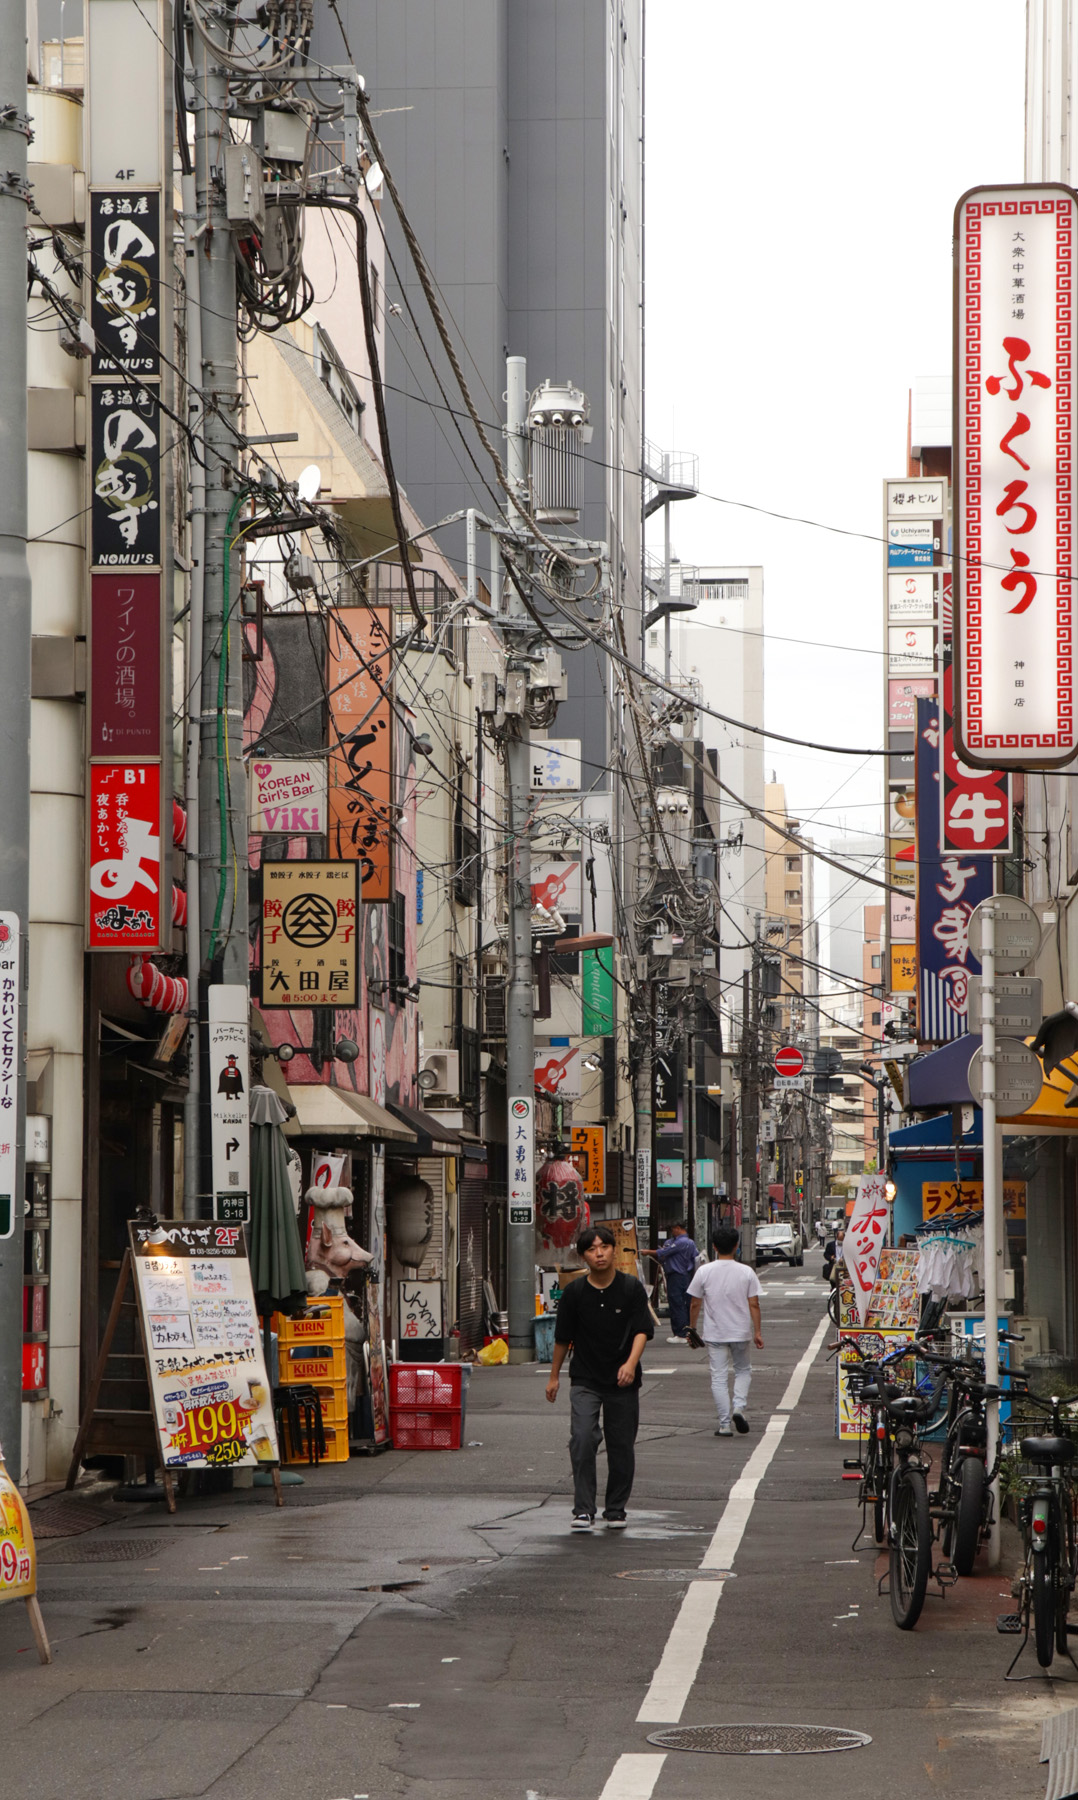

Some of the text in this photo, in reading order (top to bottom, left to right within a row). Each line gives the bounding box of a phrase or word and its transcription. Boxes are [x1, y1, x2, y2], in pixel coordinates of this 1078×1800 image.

[115, 169, 135, 180] 4F
[99, 197, 149, 214] 居酒屋
[1011, 231, 1025, 320] 大衆中華酒場
[100, 389, 150, 406] 居酒屋
[985, 336, 1051, 614] ふくろう
[934, 538, 940, 550] 6
[99, 553, 154, 564] NOMU'S
[115, 589, 136, 718] ワインの酒場。
[1014, 660, 1025, 707] 神田店
[124, 769, 145, 784] B1
[258, 772, 311, 792] KOREAN
[533, 765, 543, 786] ビル
[257, 783, 315, 804] Girl's Bar
[96, 793, 110, 853] 夜あかし。
[115, 793, 130, 853] 呑むなら、
[262, 807, 319, 830] ViKi
[263, 899, 282, 944] 餃子
[336, 898, 355, 944] 餃子
[212, 1035, 246, 1043] クラフトビール
[216, 1027, 244, 1035] バーガーと
[1, 978, 15, 1109] かわいくてセクシーな
[222, 1198, 244, 1207] 内神田
[224, 1209, 244, 1218] 3-18
[214, 1227, 240, 1247] 2F
[293, 1322, 325, 1332] KIRIN
[294, 1363, 328, 1374] KIRIN
